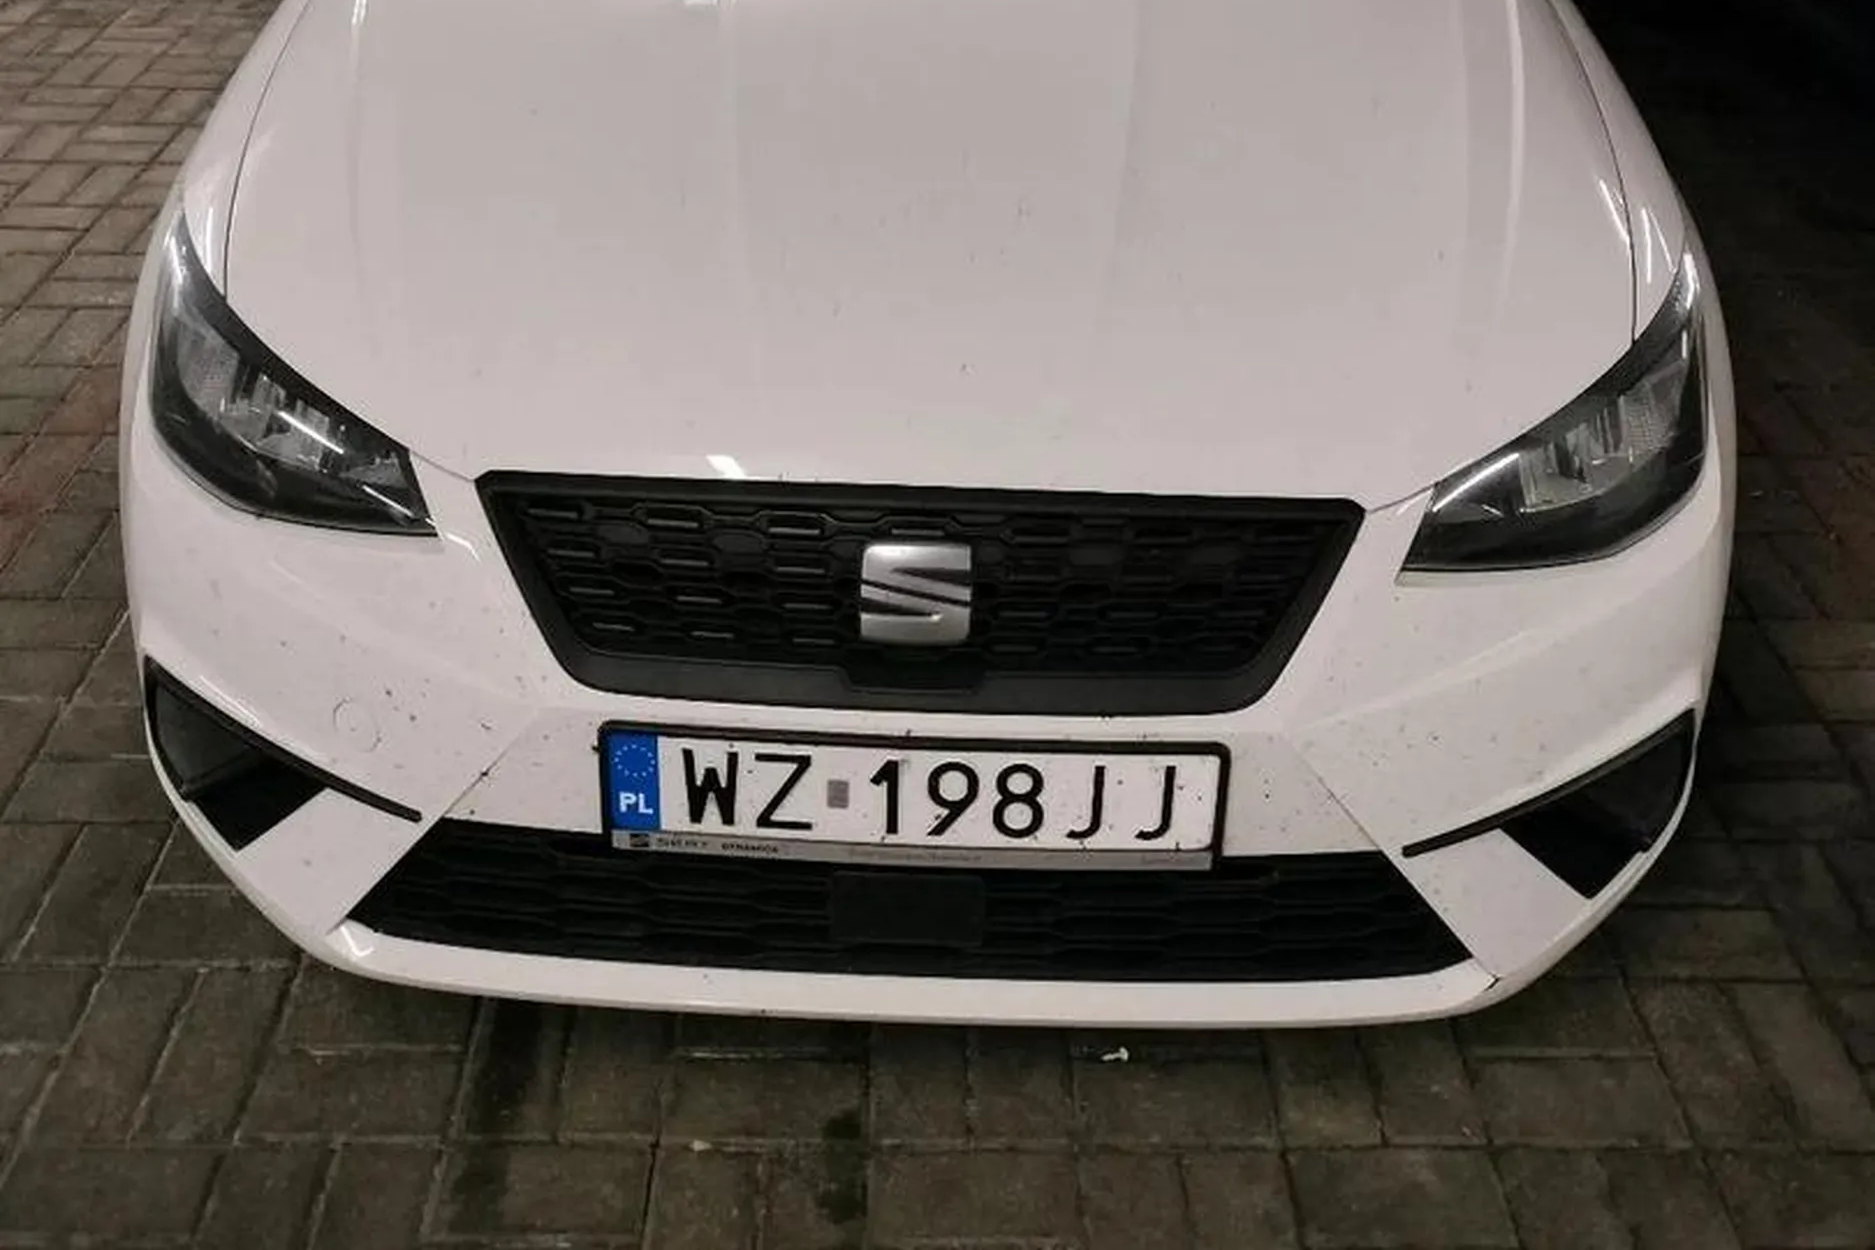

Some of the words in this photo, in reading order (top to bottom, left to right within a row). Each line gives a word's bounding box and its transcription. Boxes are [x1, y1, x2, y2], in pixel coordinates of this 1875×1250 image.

[619, 791, 654, 815] PL
[681, 747, 813, 831] WZ
[869, 759, 1177, 841] 198JJ
